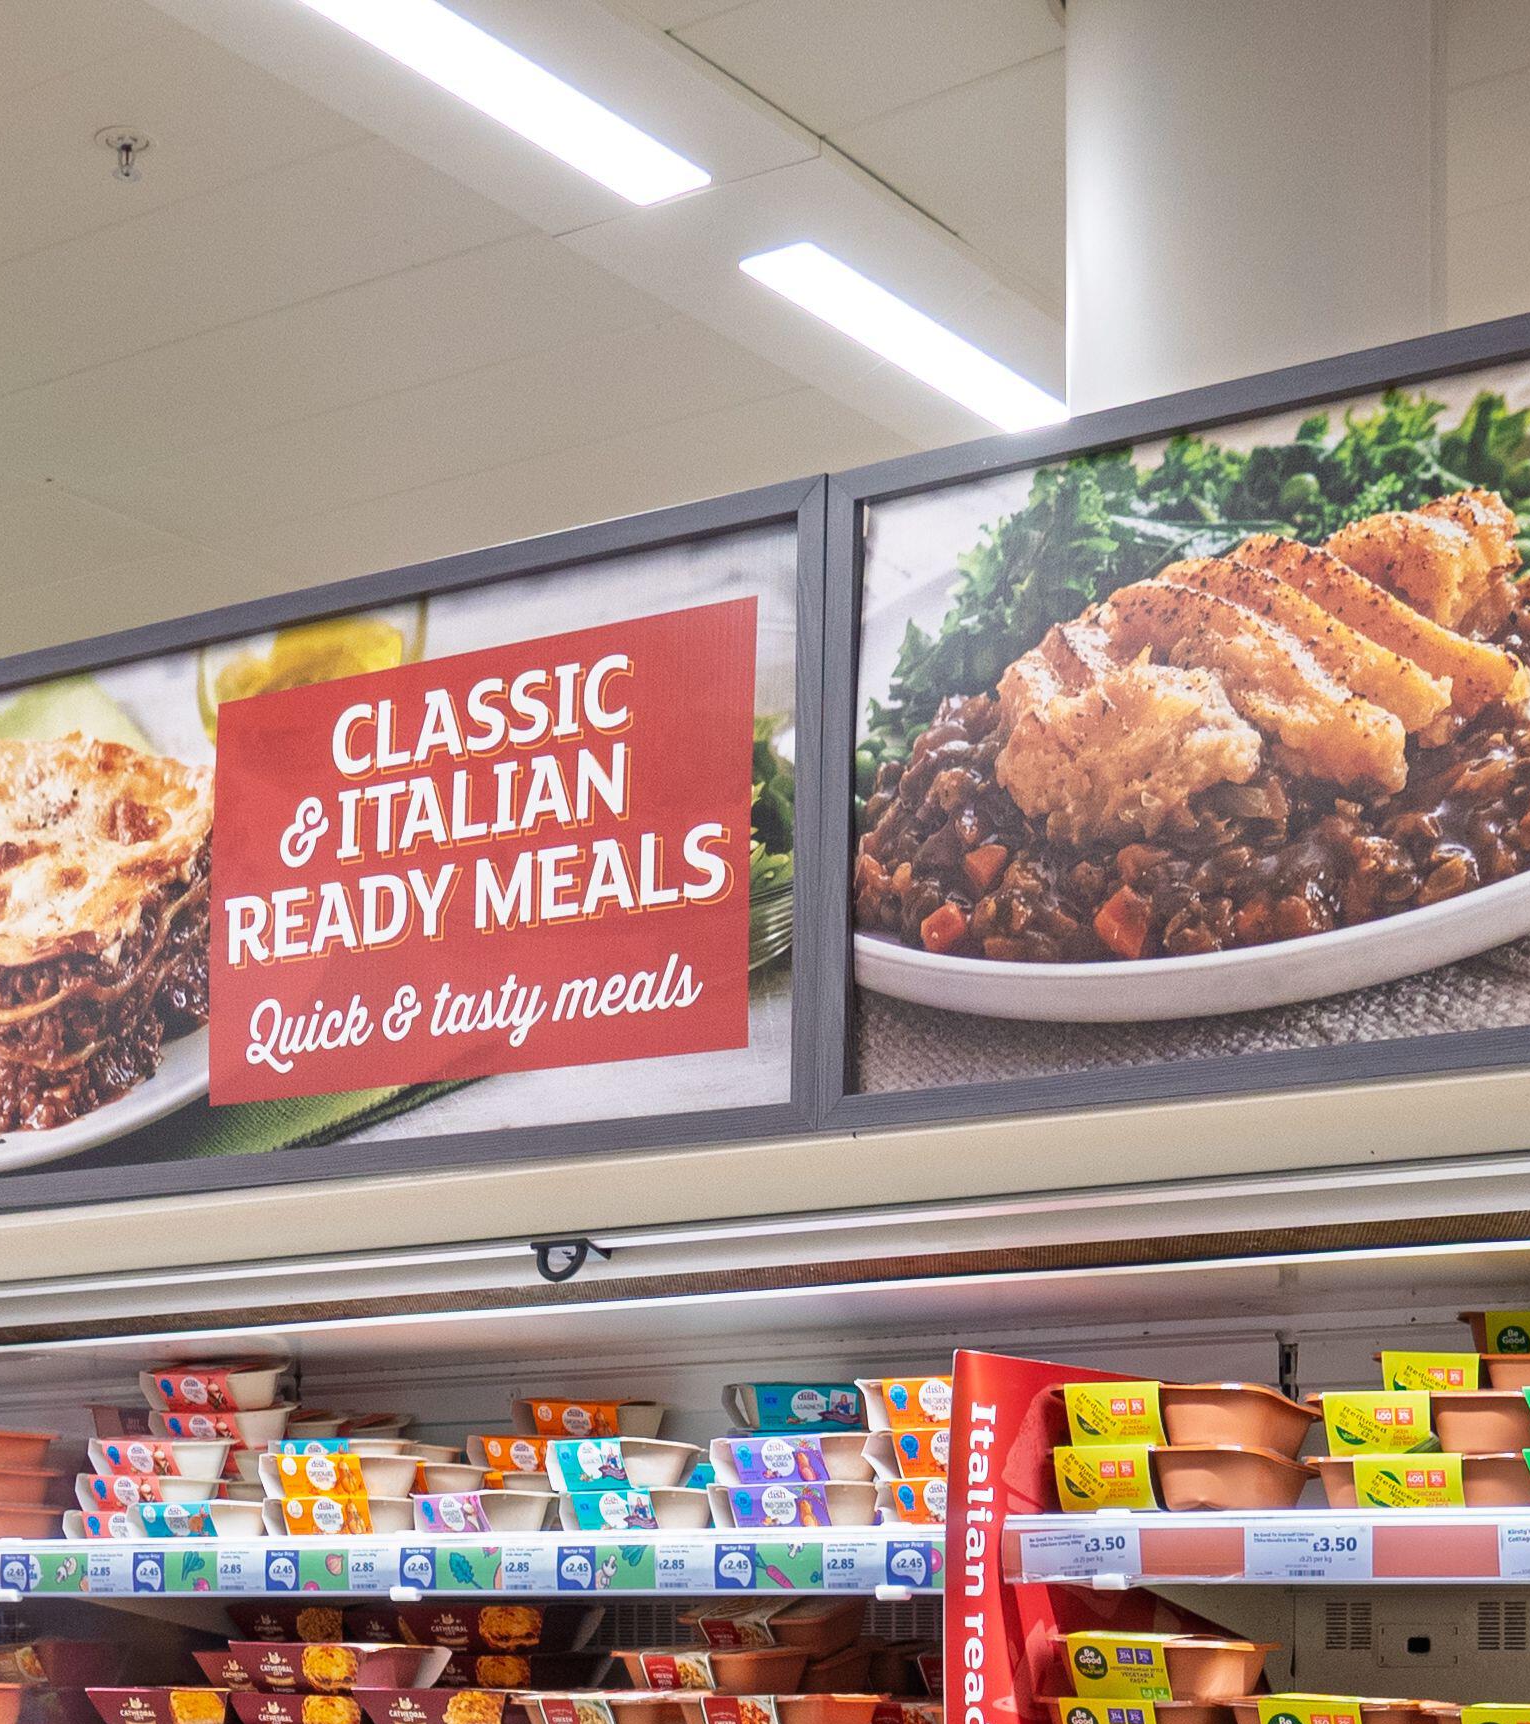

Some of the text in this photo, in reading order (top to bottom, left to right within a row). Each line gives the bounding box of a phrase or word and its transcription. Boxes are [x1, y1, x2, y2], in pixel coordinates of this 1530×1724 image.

[333, 654, 628, 775] CLASSIC
[279, 742, 626, 868] & ITALIAN
[225, 822, 725, 965] READY MEALS
[246, 953, 703, 1074] Quick & tasty meals
[966, 1401, 998, 1597] Italian
[6, 1567, 25, 1579] £2.45
[659, 1558, 685, 1571] £2.85
[724, 1559, 750, 1571] £2.45
[1084, 1536, 1126, 1553] £3.50
[1313, 1536, 1357, 1553] £3.50
